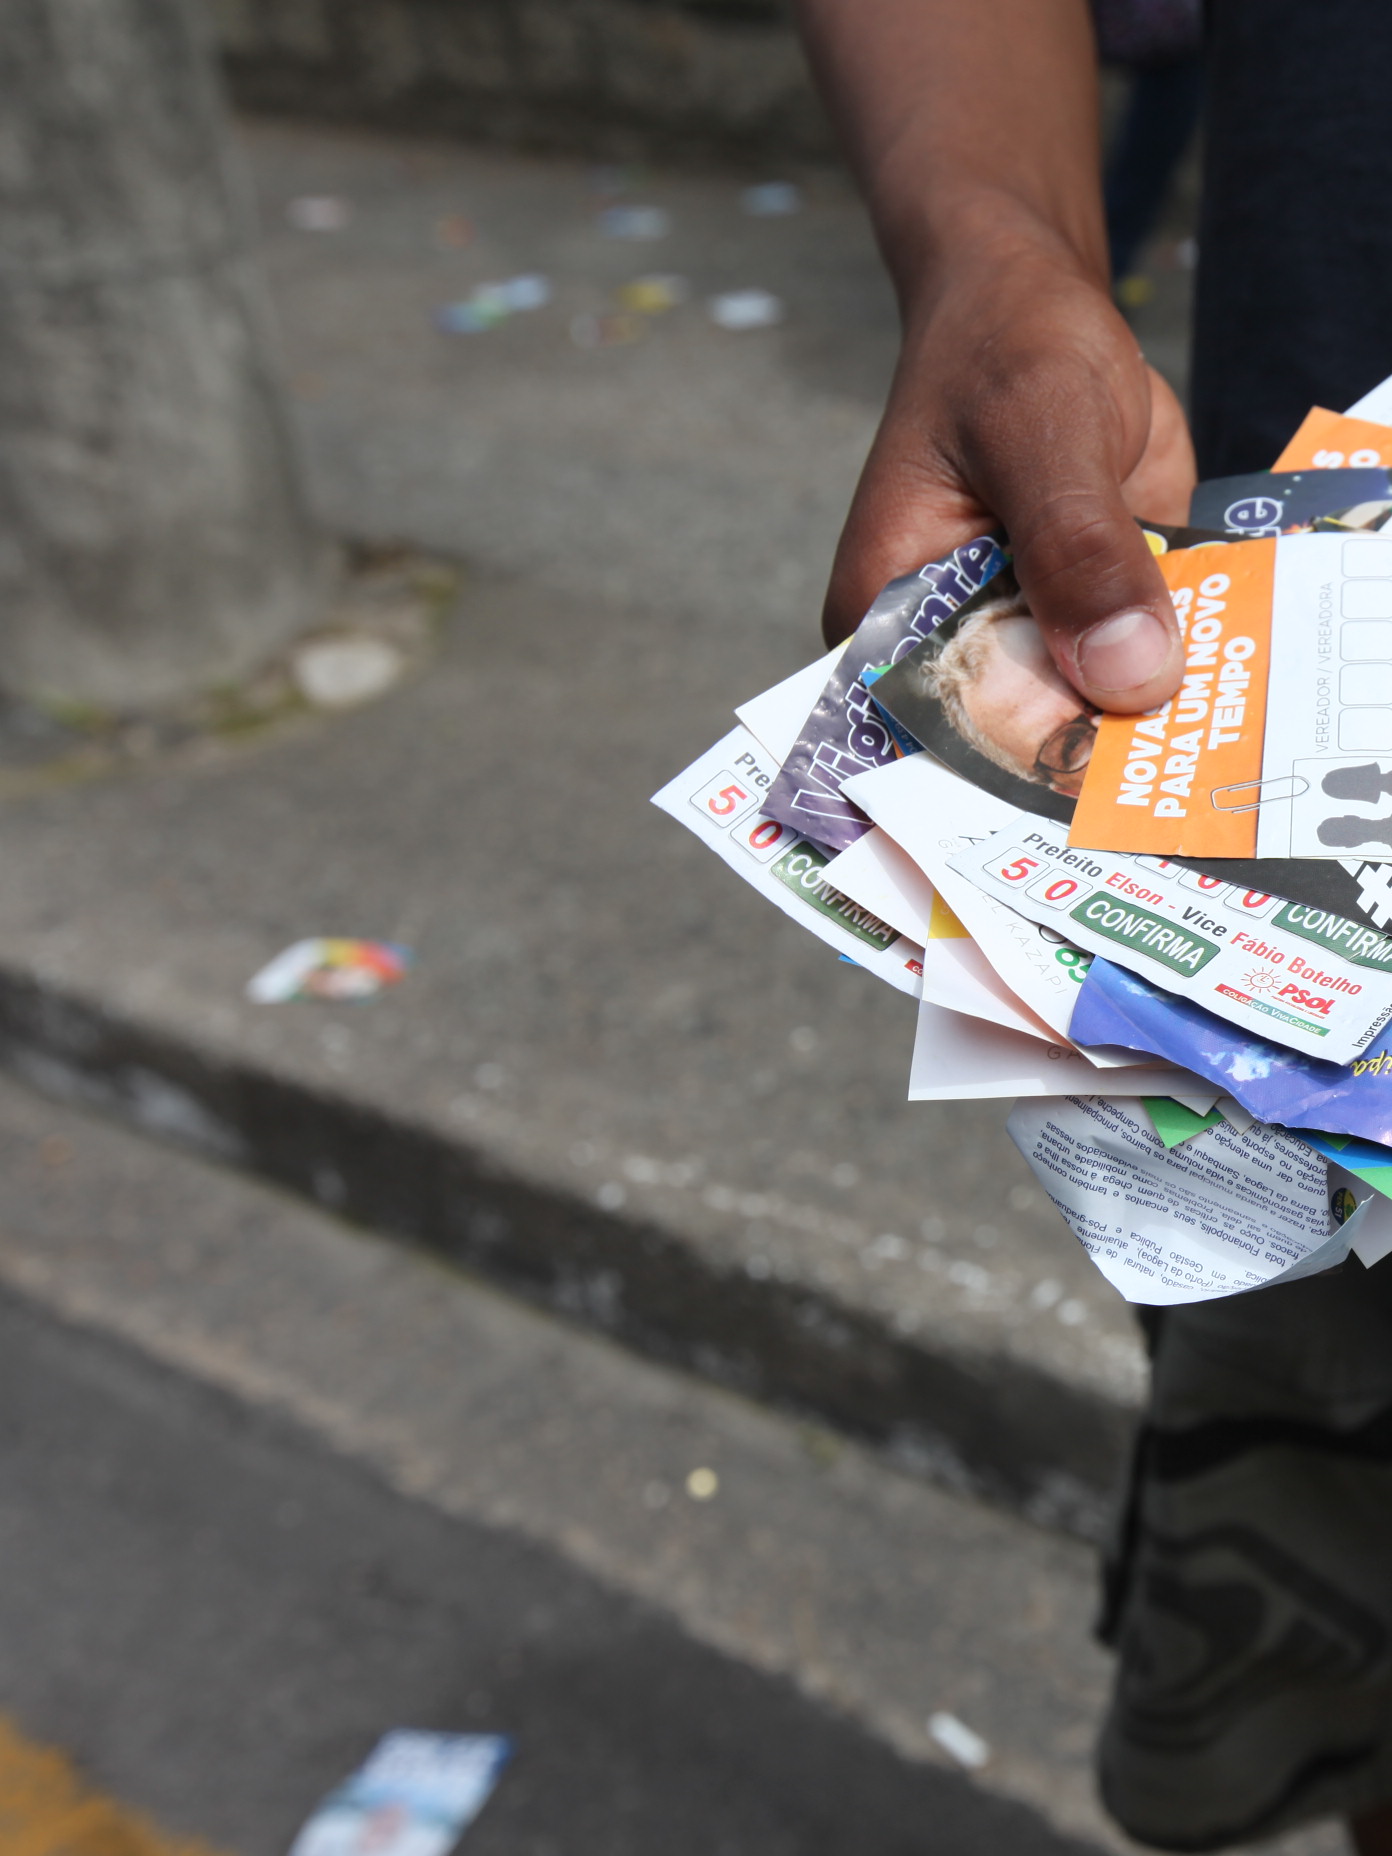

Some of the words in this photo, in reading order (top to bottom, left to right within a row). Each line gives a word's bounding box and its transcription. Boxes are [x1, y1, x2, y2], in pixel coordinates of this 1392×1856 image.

[1185, 573, 1231, 667] NOVO
[1317, 581, 1333, 666] VEREADORA
[790, 536, 1000, 826] Vignte
[1175, 673, 1214, 724] UM
[1207, 636, 1256, 750] TEMPO
[1315, 677, 1331, 753] VEREADOR
[1153, 728, 1203, 817] PARA
[708, 784, 748, 815] 5
[749, 820, 783, 850] 0
[1001, 857, 1039, 881] 5
[1044, 879, 1078, 901] 0
[1022, 833, 1103, 878] Prefeito
[1105, 872, 1164, 906] Elson
[1182, 906, 1228, 938] Vice
[1231, 931, 1285, 966] Fábio
[1288, 956, 1363, 996] Botelho
[1086, 900, 1205, 969] CONFIRMA
[1006, 921, 1067, 994] KAZAPI
[1223, 988, 1269, 1013] COLIGAÇÃO
[1277, 983, 1336, 1015] PSOL
[1097, 1095, 1140, 1134] Campeche,
[1040, 1129, 1071, 1155] urbana,
[1045, 1121, 1075, 1145] nessas
[1120, 1128, 1152, 1155] bairros,
[1141, 1129, 1166, 1149] como
[1262, 1134, 1274, 1146] já
[1044, 1147, 1060, 1162] Ilha
[1153, 1151, 1165, 1161] os
[1186, 1144, 1193, 1152] e
[1214, 1133, 1250, 1159] atenção
[1241, 1135, 1275, 1161] esporte
[1032, 1151, 1068, 1177] conheço
[1074, 1153, 1127, 1176] mobilidade
[1076, 1142, 1139, 1171] evidenciados
[1166, 1158, 1189, 1173] para
[1194, 1149, 1240, 1180] Sambaqui
[1251, 1157, 1273, 1172] uma
[1279, 1160, 1293, 1171] no
[1061, 1157, 1088, 1177] nossa
[1090, 1172, 1098, 1181] à
[1140, 1168, 1163, 1183] mais
[1205, 1167, 1225, 1182] vida
[1276, 1171, 1293, 1183] dar
[1069, 1174, 1108, 1196] também
[1103, 1175, 1133, 1190] chega
[1132, 1174, 1159, 1188] como
[1165, 1181, 1177, 1189] os
[1188, 1170, 1234, 1195] municipal
[1243, 1174, 1274, 1197] Lagoa,
[1297, 1182, 1326, 1197] quero
[1138, 1186, 1165, 1201] quem
[1163, 1187, 1214, 1214] Problemas
[1167, 1197, 1180, 1207] de
[1179, 1187, 1197, 1197] são
[1235, 1183, 1304, 1219] gastronômicas
[1276, 1192, 1289, 1202] da
[1125, 1193, 1169, 1213] encantos
[1198, 1196, 1257, 1223] saneamento
[1235, 1193, 1269, 1212] guarda
[1290, 1199, 1317, 1216] Barra
[1173, 1210, 1197, 1226] seus
[1184, 1205, 1218, 1223] críticas
[1278, 1214, 1306, 1231] trazer
[1305, 1216, 1325, 1226] vias
[1223, 1221, 1235, 1230] as
[1077, 1226, 1129, 1250] atualmente
[1130, 1232, 1163, 1255] Pública
[1199, 1220, 1260, 1257] Florianópolis,
[1240, 1229, 1265, 1245] Ouço
[1105, 1248, 1118, 1259] de
[1264, 1252, 1286, 1268] toda
[1269, 1240, 1299, 1261] fracos.
[1123, 1257, 1155, 1277] natural
[1169, 1251, 1204, 1273] Gestão
[1170, 1266, 1183, 1277] da
[1160, 1273, 1194, 1290] casado,
[1211, 1270, 1227, 1281] em
